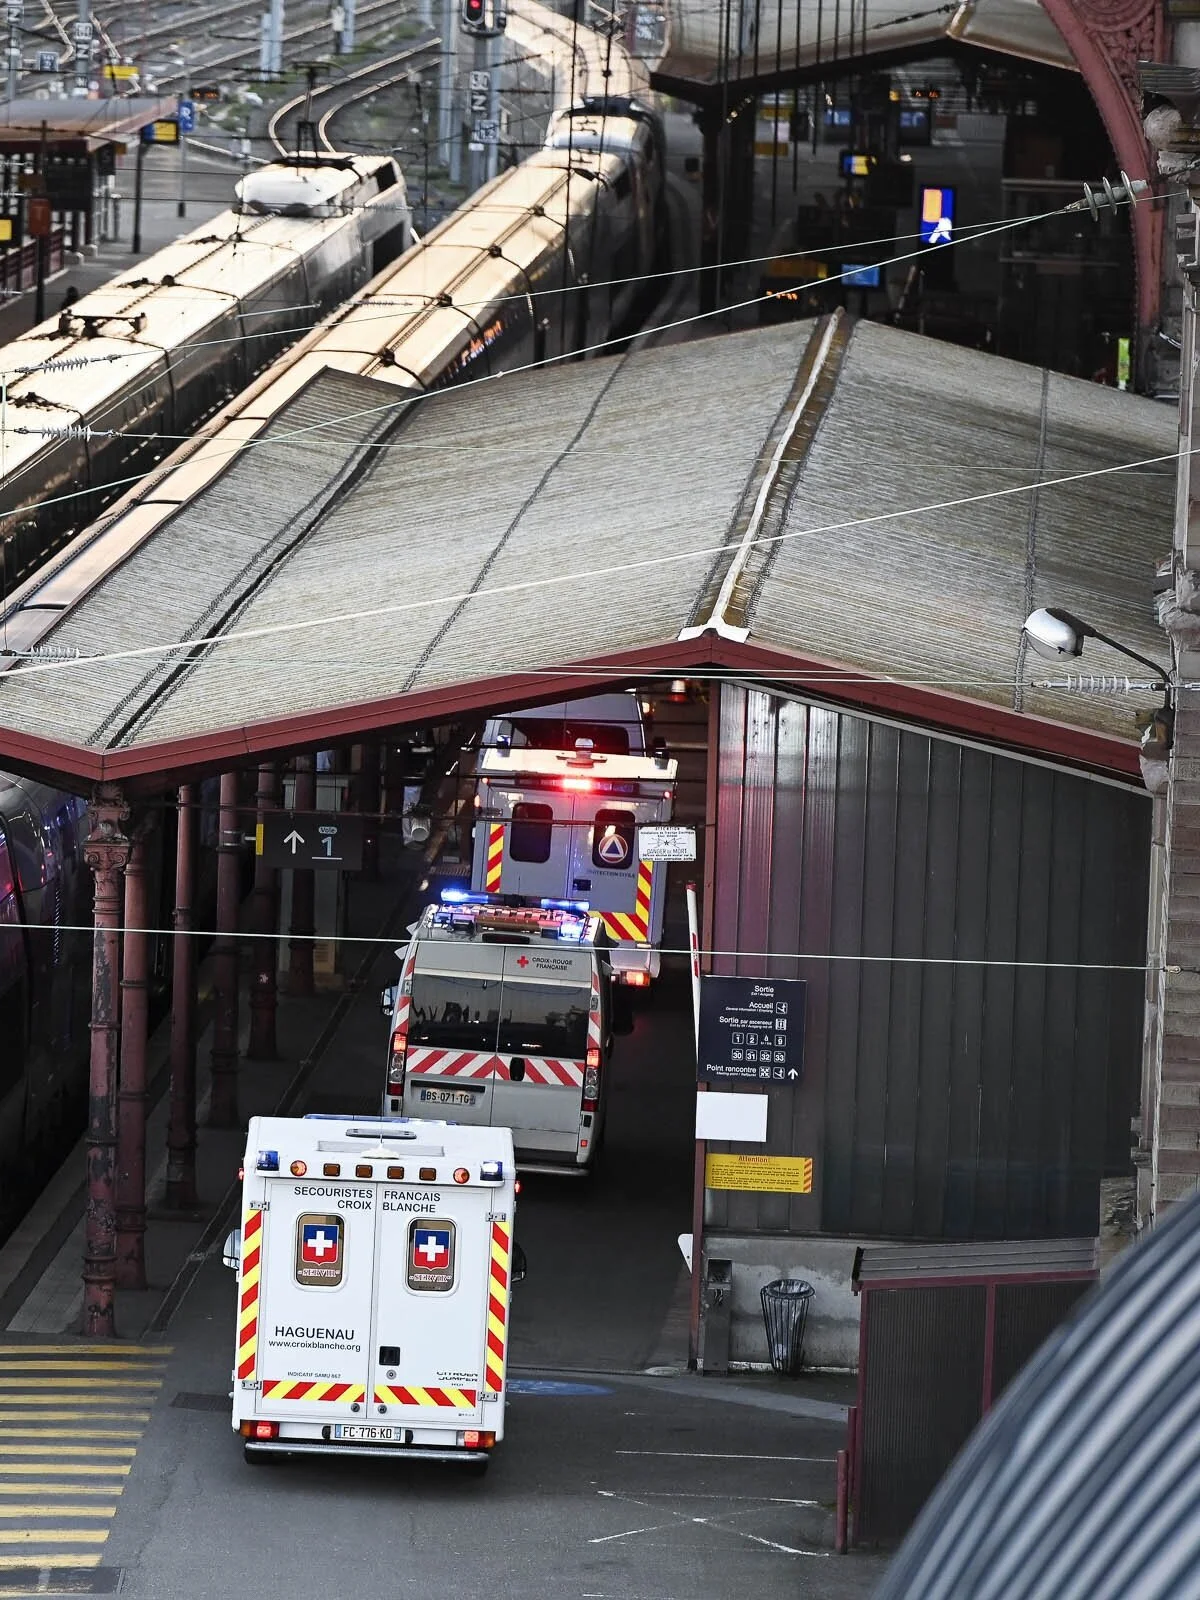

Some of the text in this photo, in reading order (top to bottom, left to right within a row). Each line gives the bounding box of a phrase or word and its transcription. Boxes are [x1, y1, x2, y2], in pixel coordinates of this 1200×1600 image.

[321, 836, 332, 856] 1
[754, 985, 775, 993] Sortie
[749, 1001, 774, 1009] Accueil
[719, 1015, 739, 1024] Sortie
[761, 1053, 770, 1061] 32
[706, 1064, 757, 1074] Point rencontre
[294, 1186, 441, 1202] SECOURISTES FRANCAIS
[337, 1200, 436, 1213] CROIX BLANCHE
[275, 1325, 355, 1341] HAGUENAU
[268, 1340, 361, 1353] www.croixblanche.org
